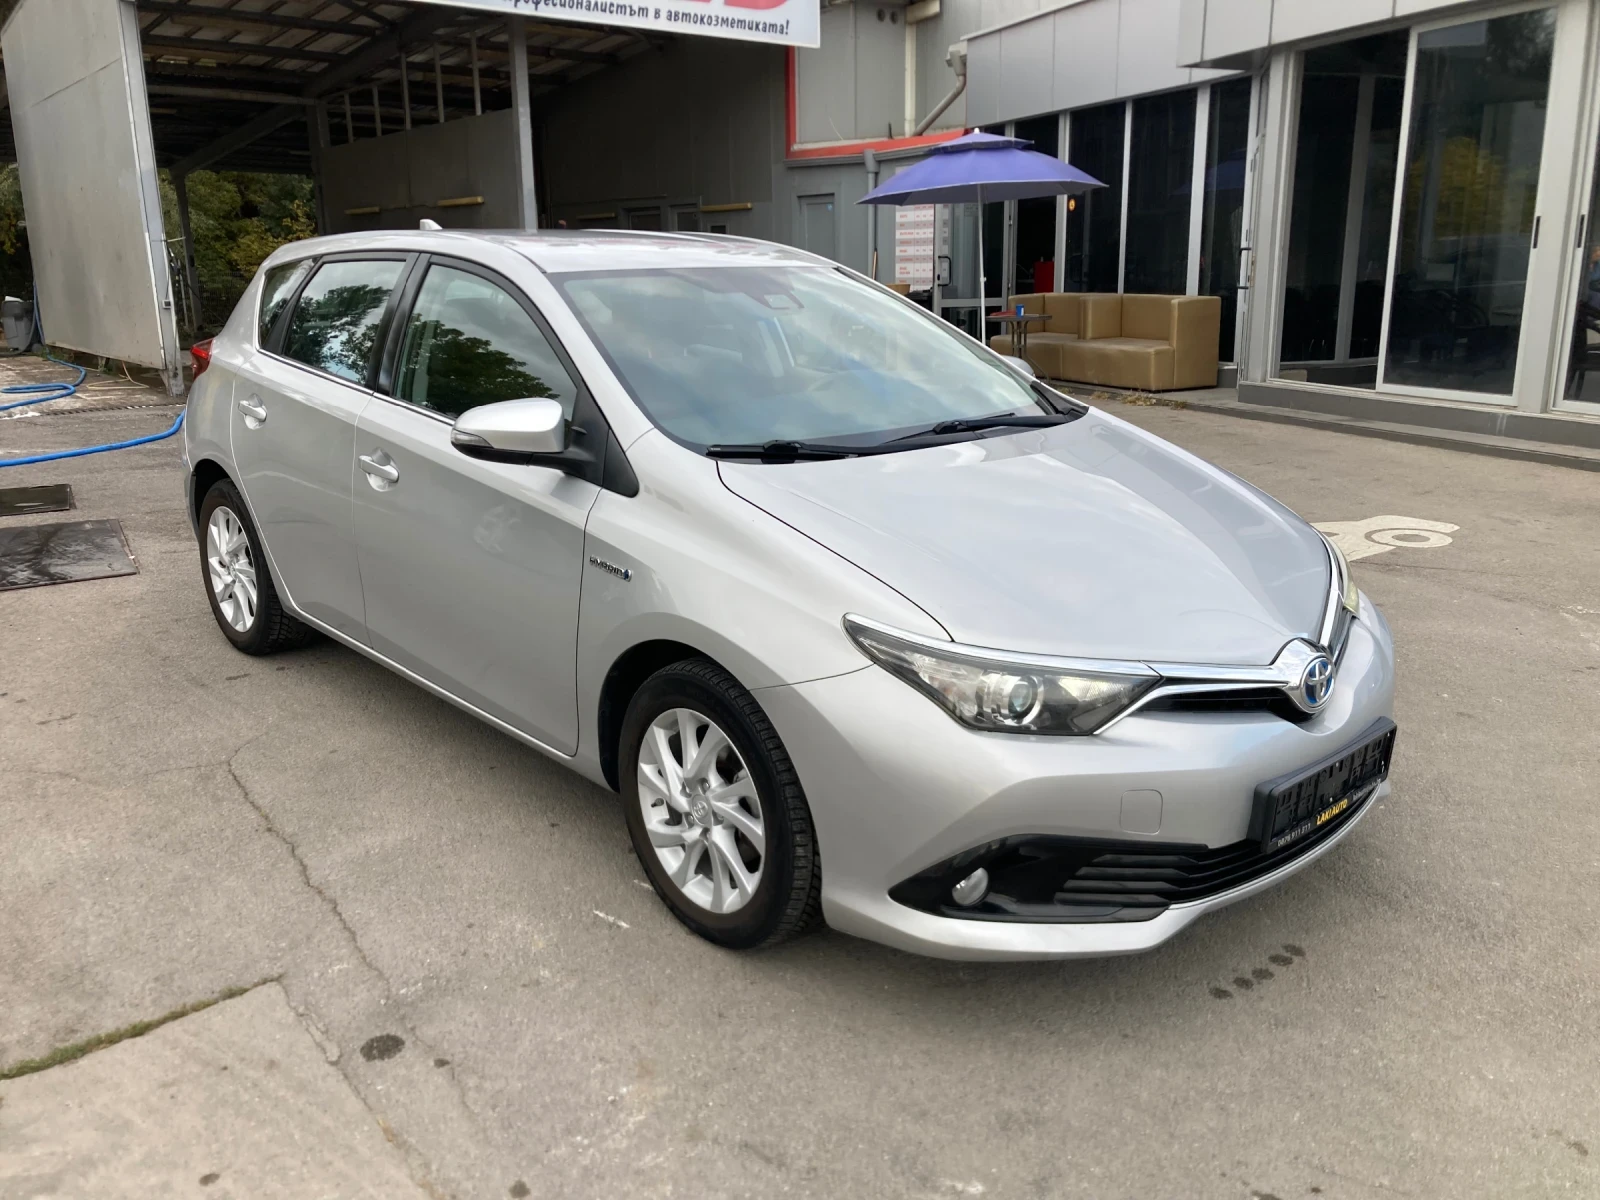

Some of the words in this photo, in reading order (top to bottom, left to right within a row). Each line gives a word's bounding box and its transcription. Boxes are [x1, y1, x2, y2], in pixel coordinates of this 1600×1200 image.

[503, 0, 649, 18] рфесионалистът
[654, 8, 661, 19] в
[666, 10, 789, 35] автокозметиката!
